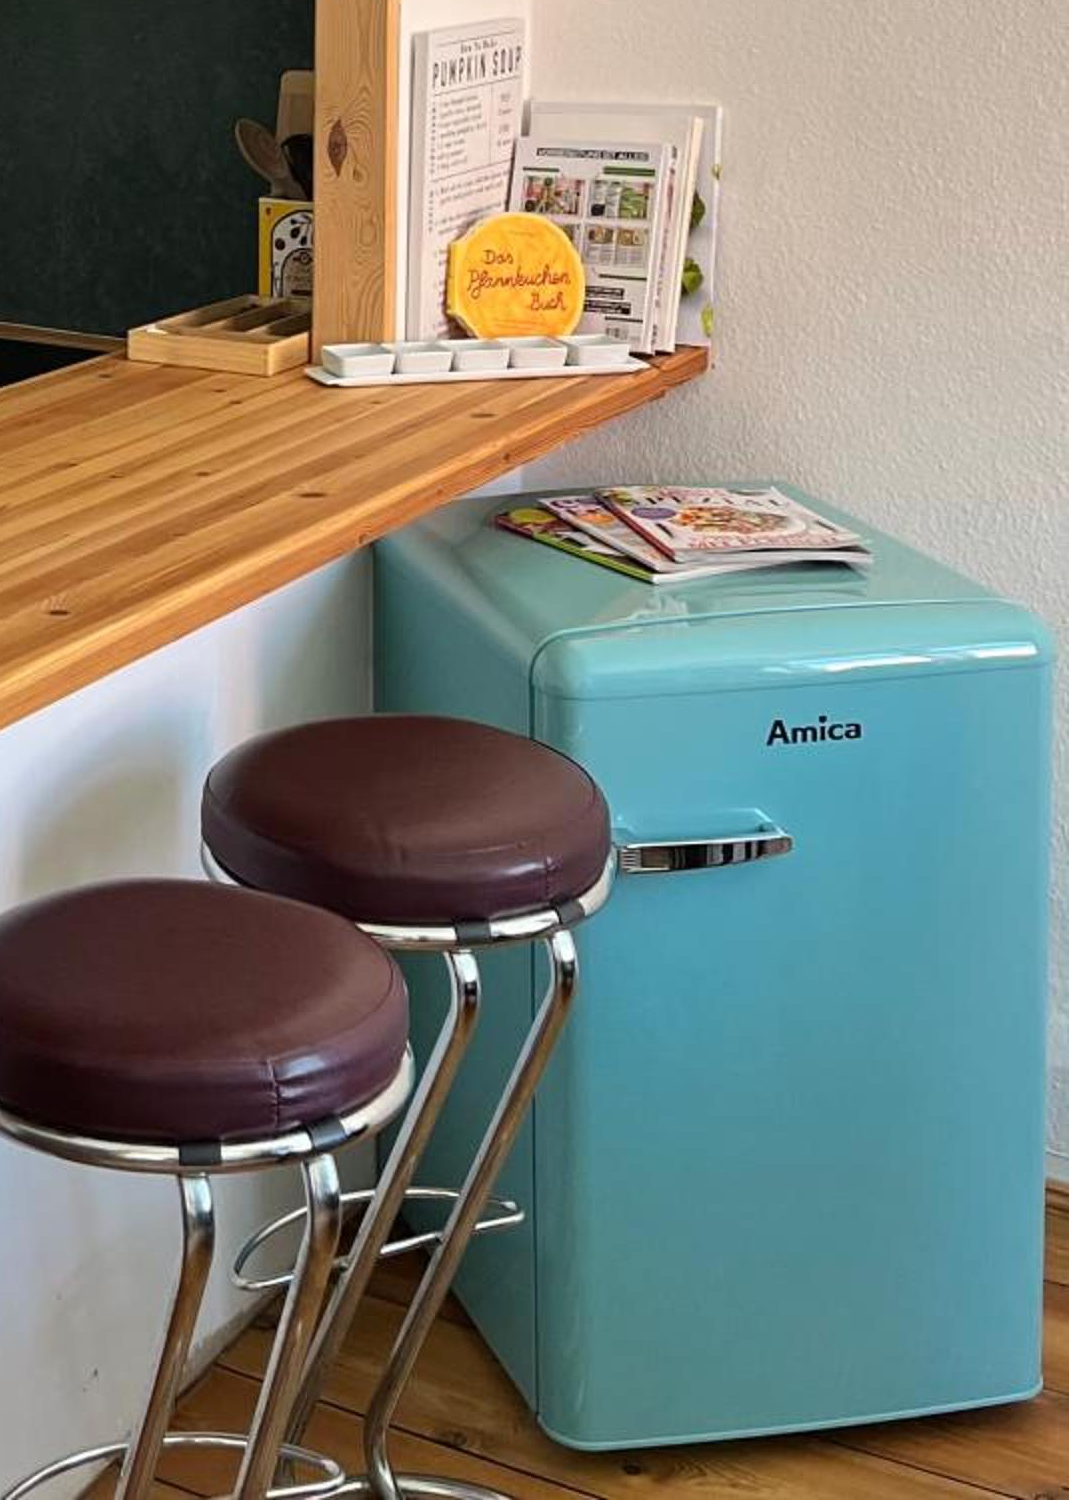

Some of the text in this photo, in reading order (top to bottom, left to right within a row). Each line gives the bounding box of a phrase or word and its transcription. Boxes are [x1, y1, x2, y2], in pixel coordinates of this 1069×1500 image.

[433, 45, 521, 88] PUMPKIN SOUP
[483, 249, 514, 265] Das
[528, 291, 567, 312] Buch
[766, 715, 862, 746] Amica
